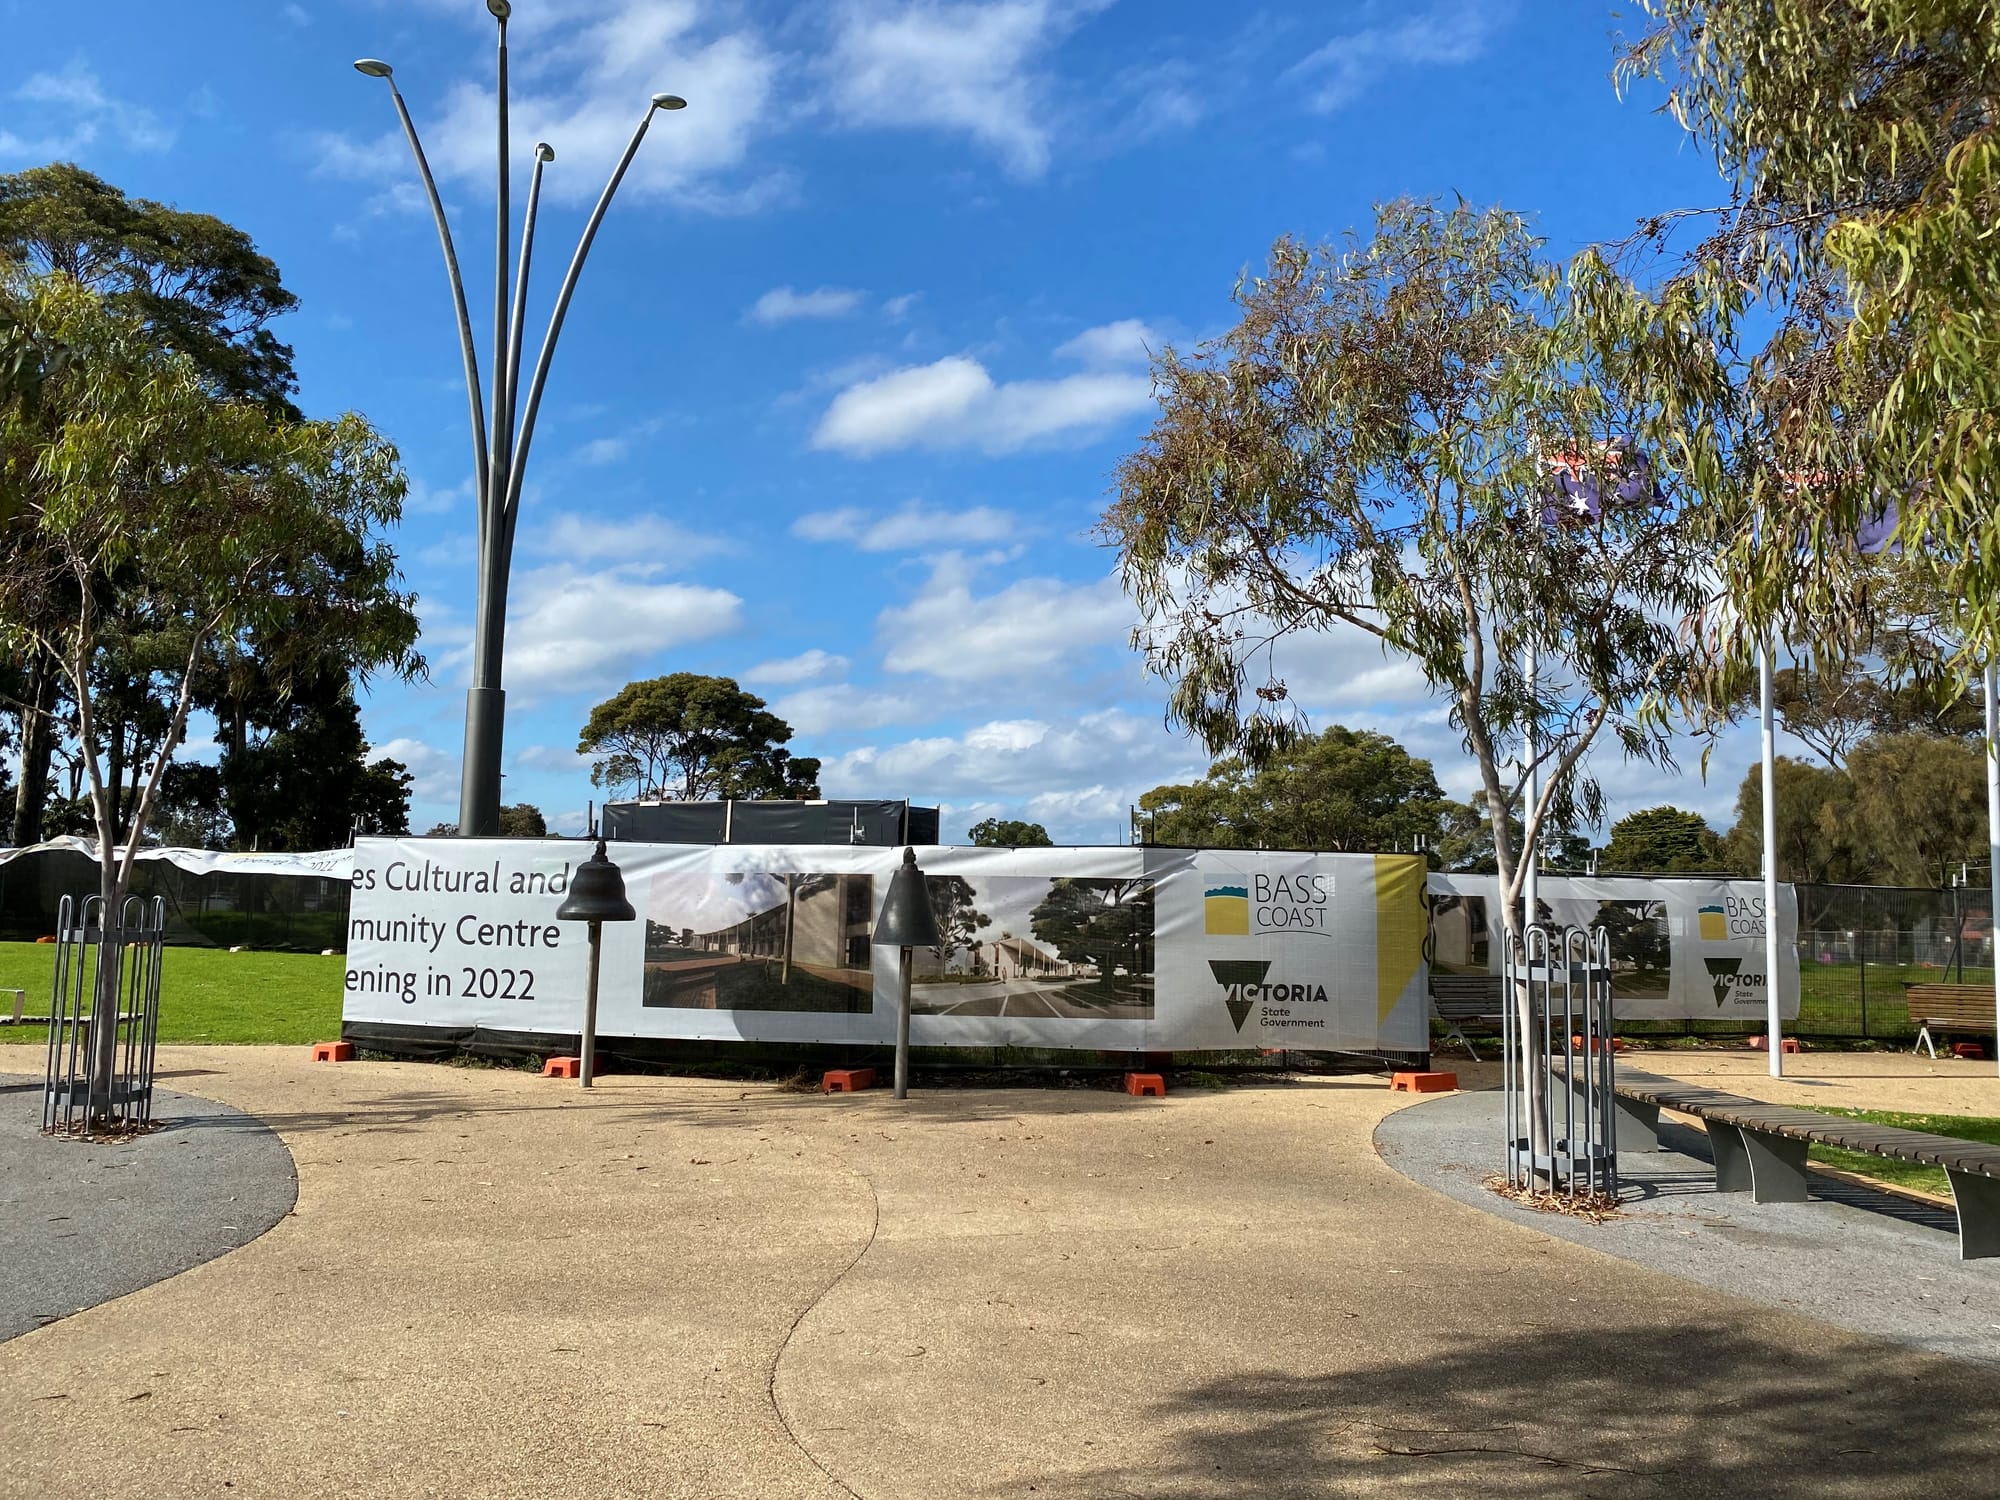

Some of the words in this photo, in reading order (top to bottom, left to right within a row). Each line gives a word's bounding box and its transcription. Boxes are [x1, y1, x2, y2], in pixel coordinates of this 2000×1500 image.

[351, 868, 376, 890] es
[385, 860, 500, 893] Cultural
[509, 863, 570, 895] and
[1255, 874, 1327, 904] BASS
[1257, 907, 1327, 928] COAST
[350, 914, 446, 953] munity
[456, 915, 561, 948] Centre
[1731, 920, 1766, 934] COAS
[345, 963, 417, 1004] ening
[427, 966, 452, 996] in
[461, 967, 536, 1001] 2022
[1711, 974, 1768, 988] VICTORI
[1221, 984, 1328, 1002] VICTORIA
[1735, 990, 1754, 998] State
[1261, 1007, 1291, 1017] State
[1260, 1017, 1325, 1029] Government
